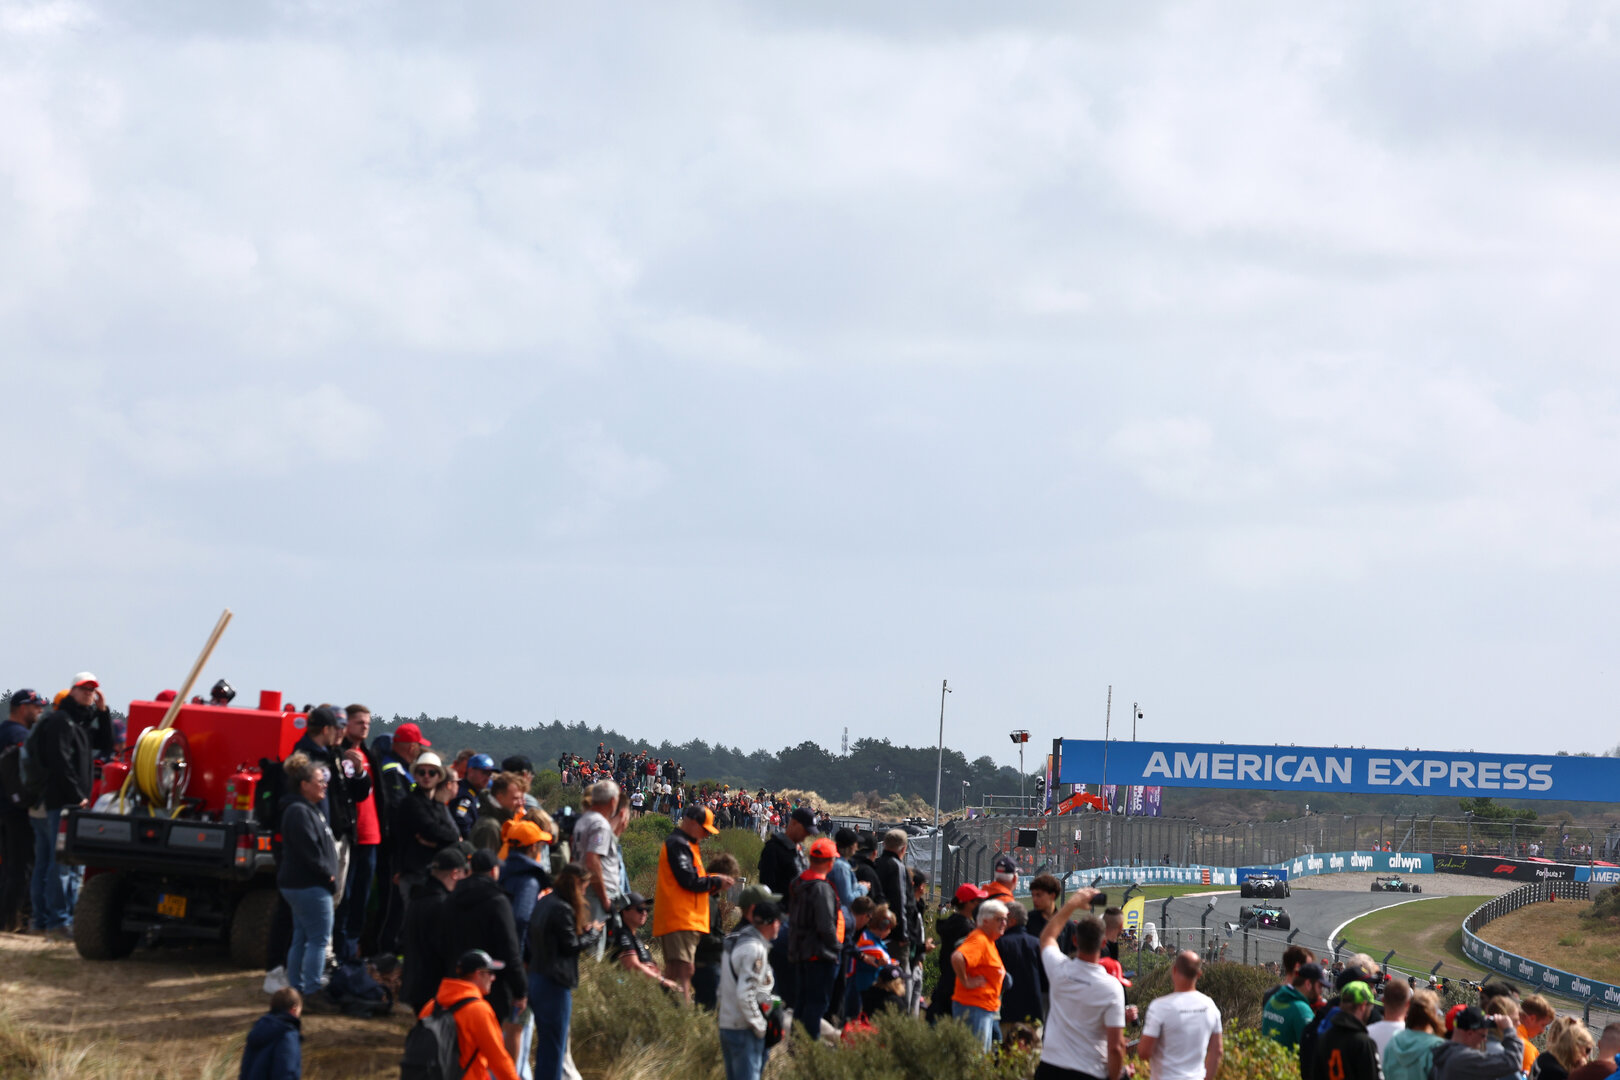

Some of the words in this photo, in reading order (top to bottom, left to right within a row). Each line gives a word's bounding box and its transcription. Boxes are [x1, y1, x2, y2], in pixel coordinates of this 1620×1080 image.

[1141, 751, 1353, 784] AMERICAN
[1367, 758, 1554, 791] EXPRESS
[1388, 853, 1421, 873] allwyn
[1571, 977, 1591, 998] allwyn
